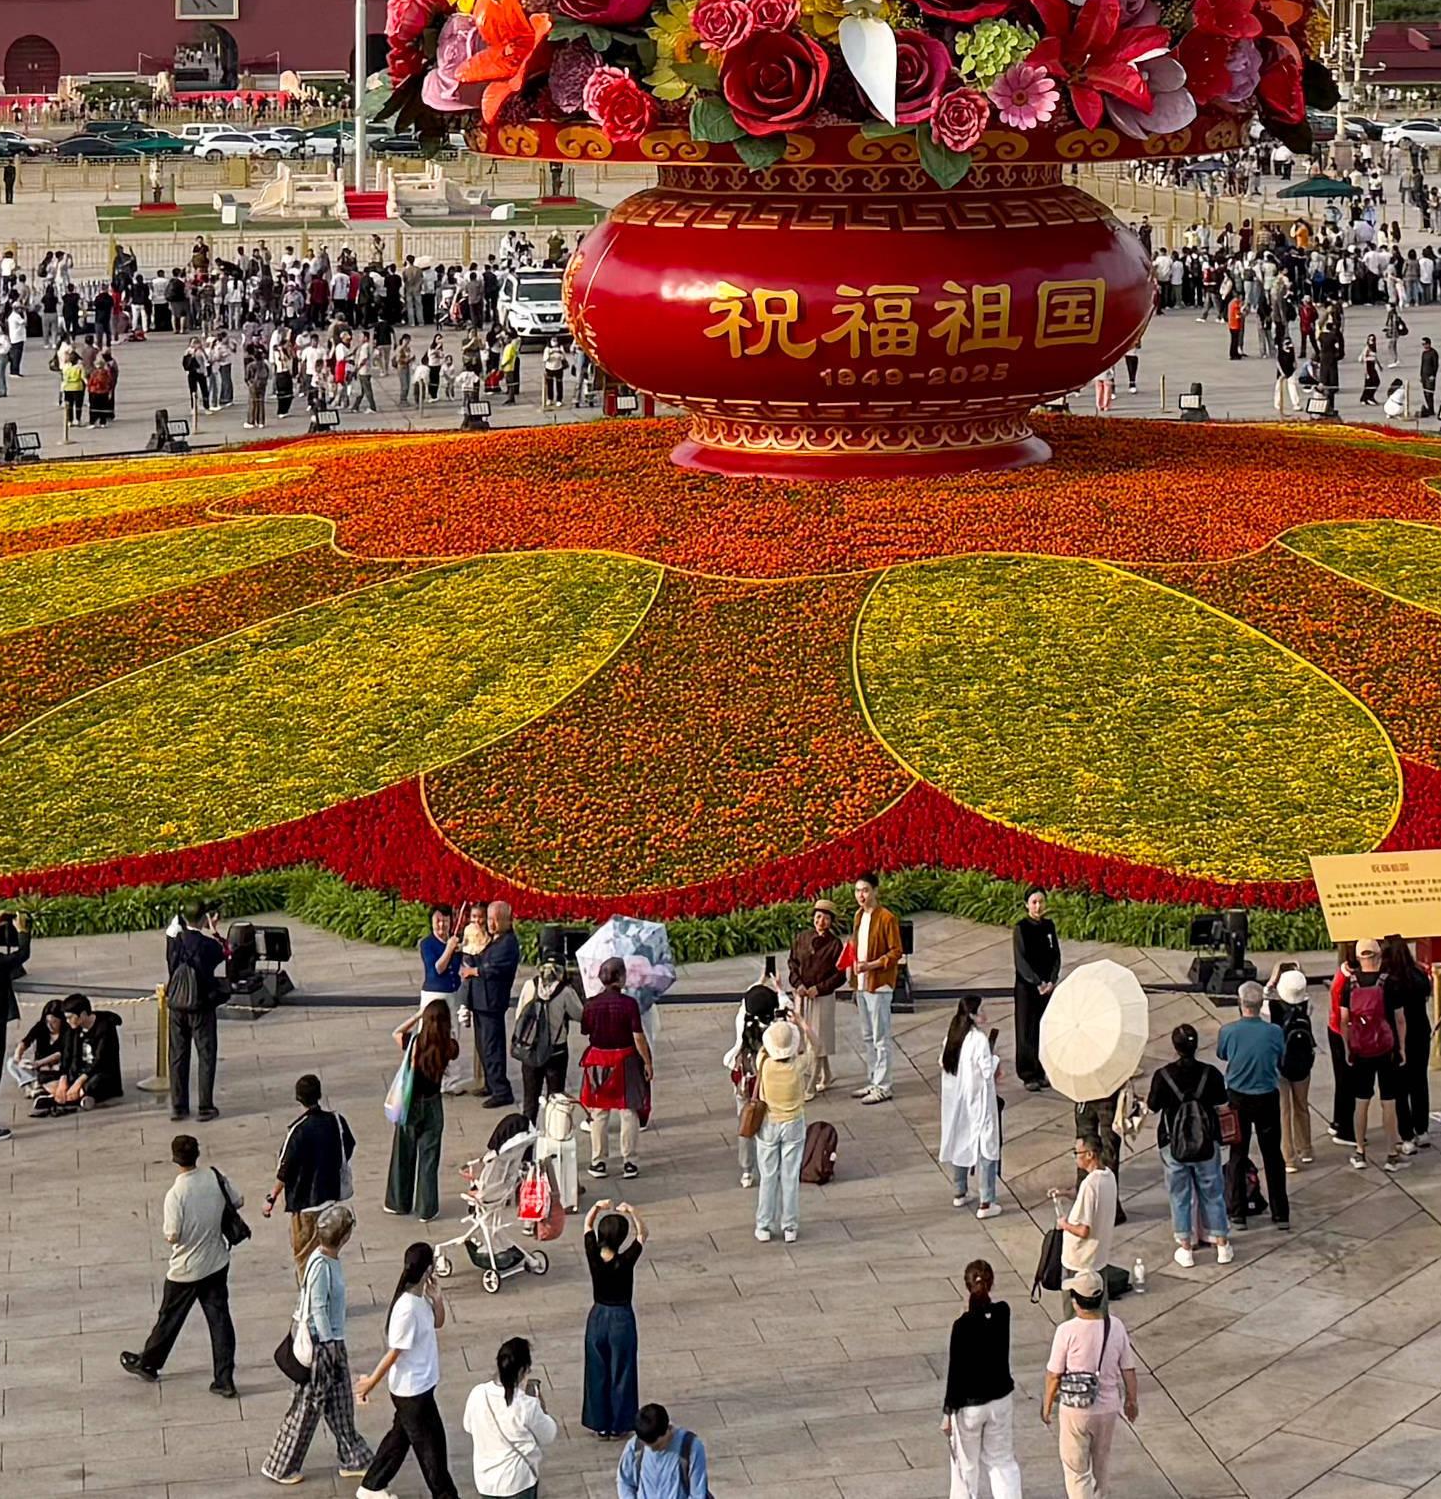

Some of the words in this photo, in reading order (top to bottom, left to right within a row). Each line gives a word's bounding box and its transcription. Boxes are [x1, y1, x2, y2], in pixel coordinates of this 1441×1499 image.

[703, 278, 1107, 359] 祝福祖国
[819, 363, 1009, 387] 1949-2025
